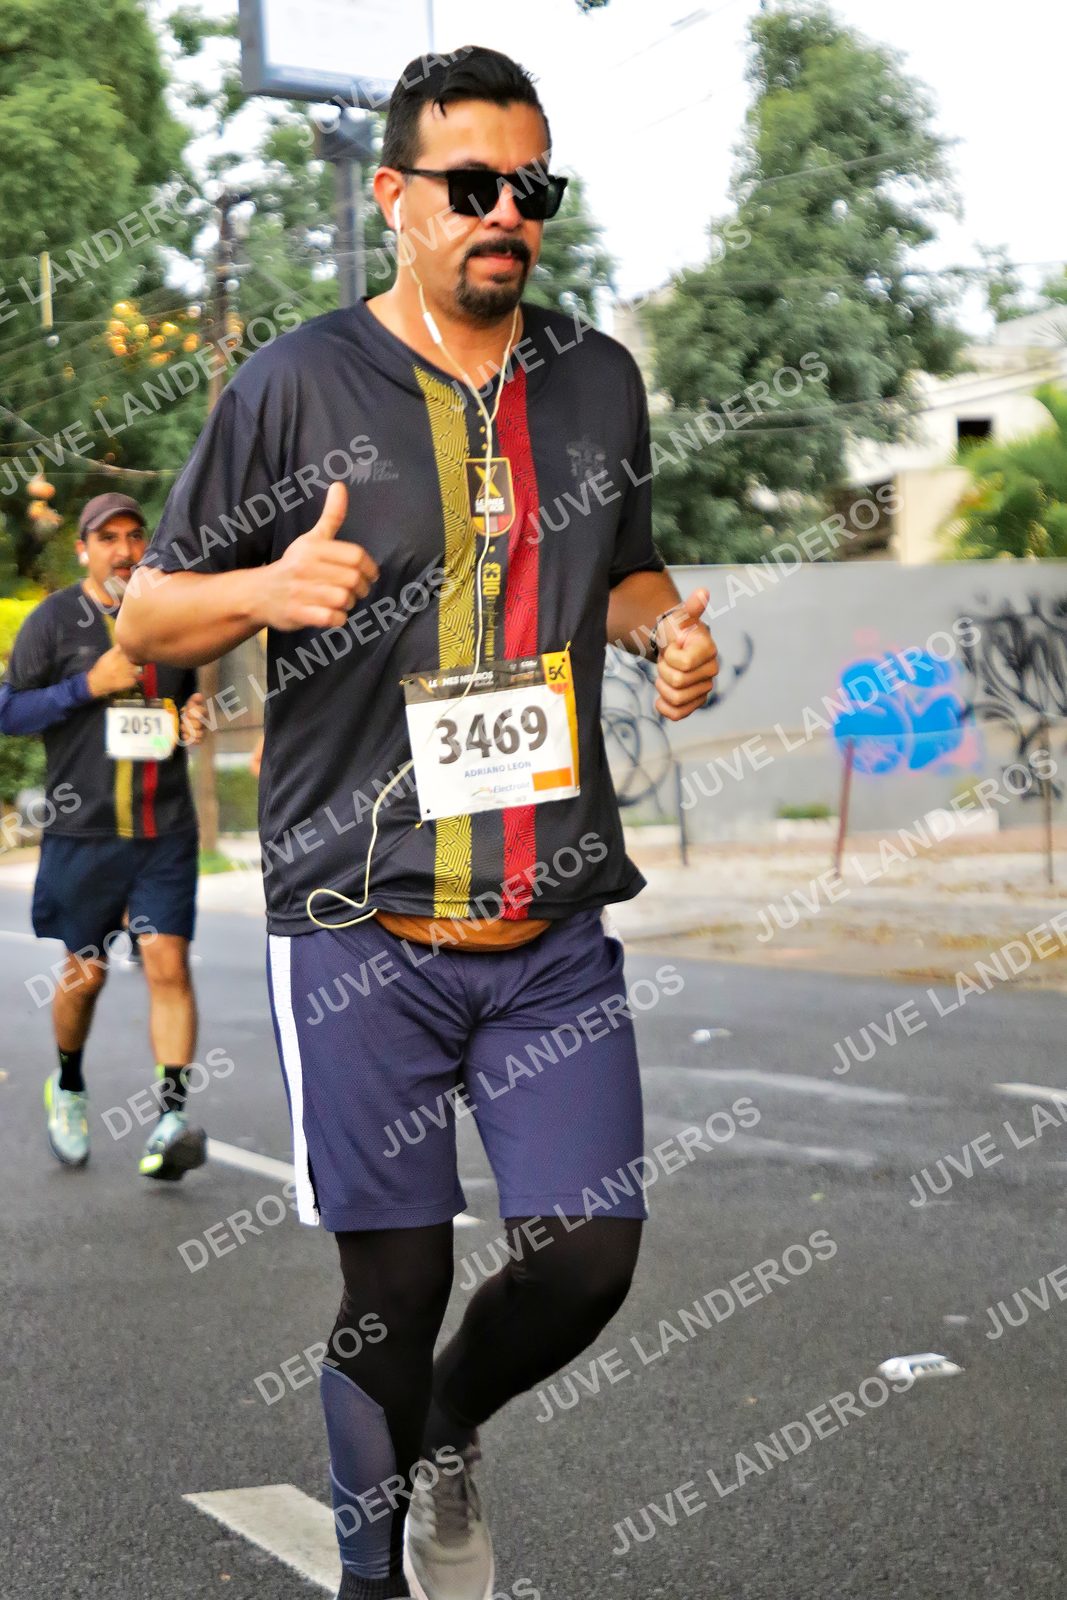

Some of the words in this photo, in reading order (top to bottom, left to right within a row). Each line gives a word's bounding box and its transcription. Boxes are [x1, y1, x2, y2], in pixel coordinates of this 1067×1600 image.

[548, 664, 567, 681] 5K
[119, 714, 163, 735] 2051
[436, 705, 548, 765] 3469
[464, 764, 507, 778] ADRIANO
[507, 759, 532, 772] LEON
